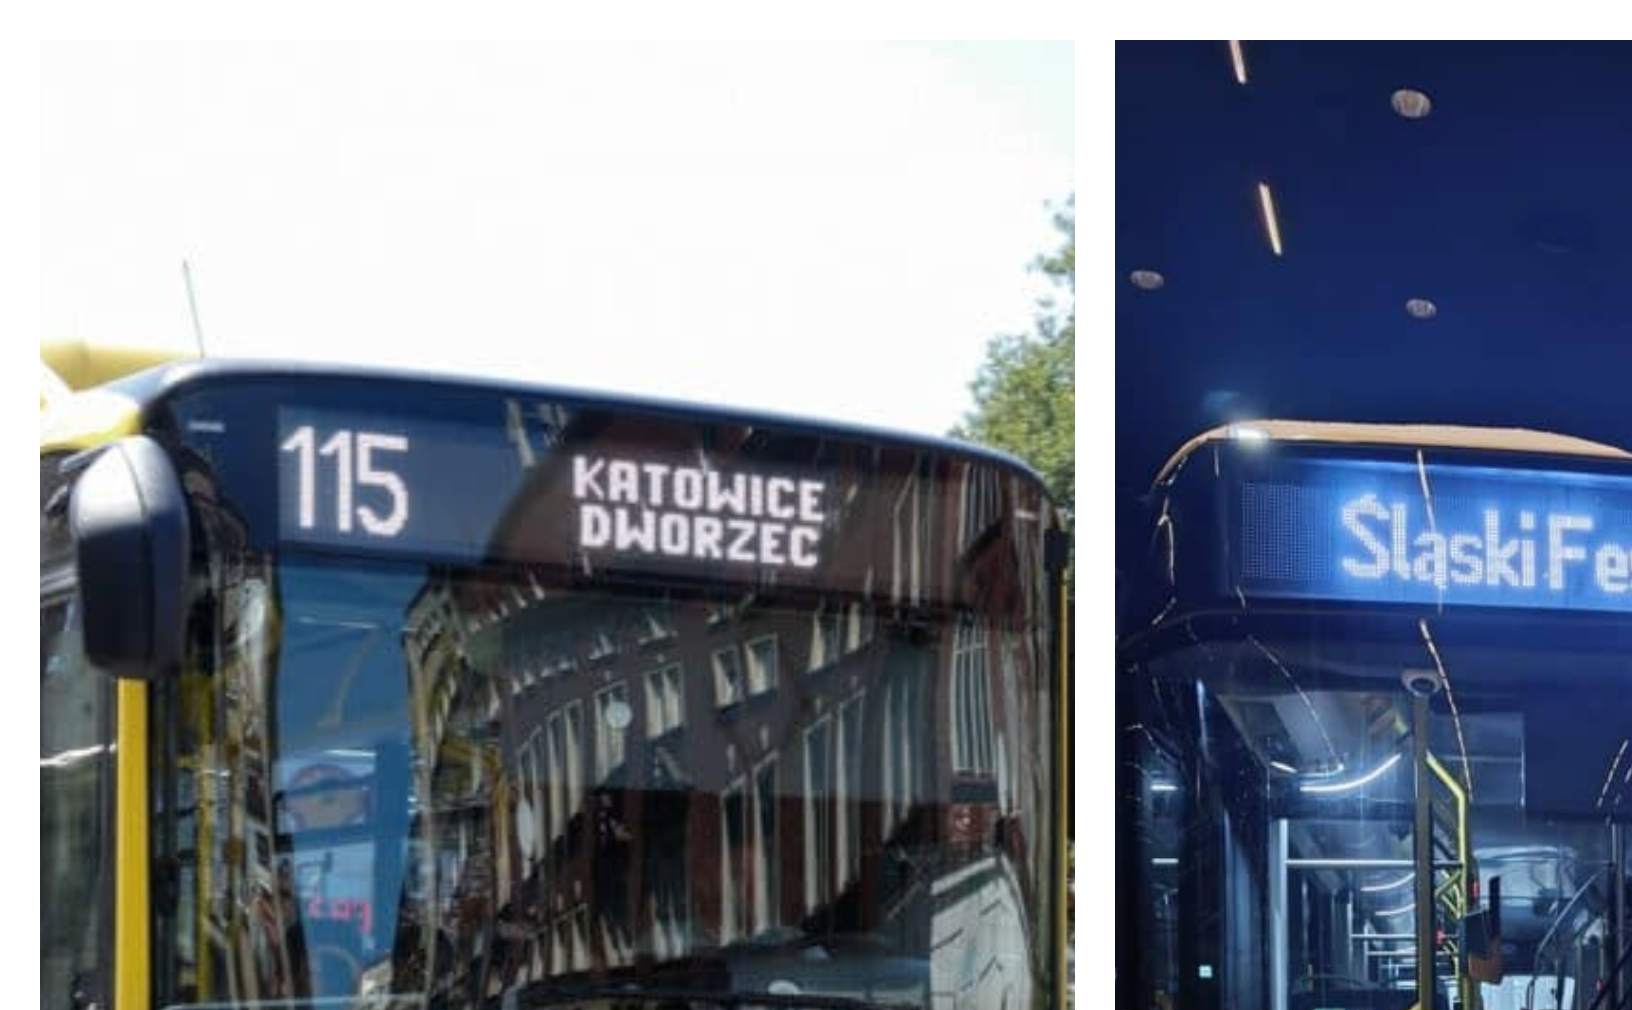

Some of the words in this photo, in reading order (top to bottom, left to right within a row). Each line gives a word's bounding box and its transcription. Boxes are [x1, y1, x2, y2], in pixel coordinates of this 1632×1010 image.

[281, 425, 409, 537] 115
[572, 455, 826, 521] KATOWICE
[580, 503, 818, 567] DWORZEC
[1341, 494, 1536, 590] Śląski
